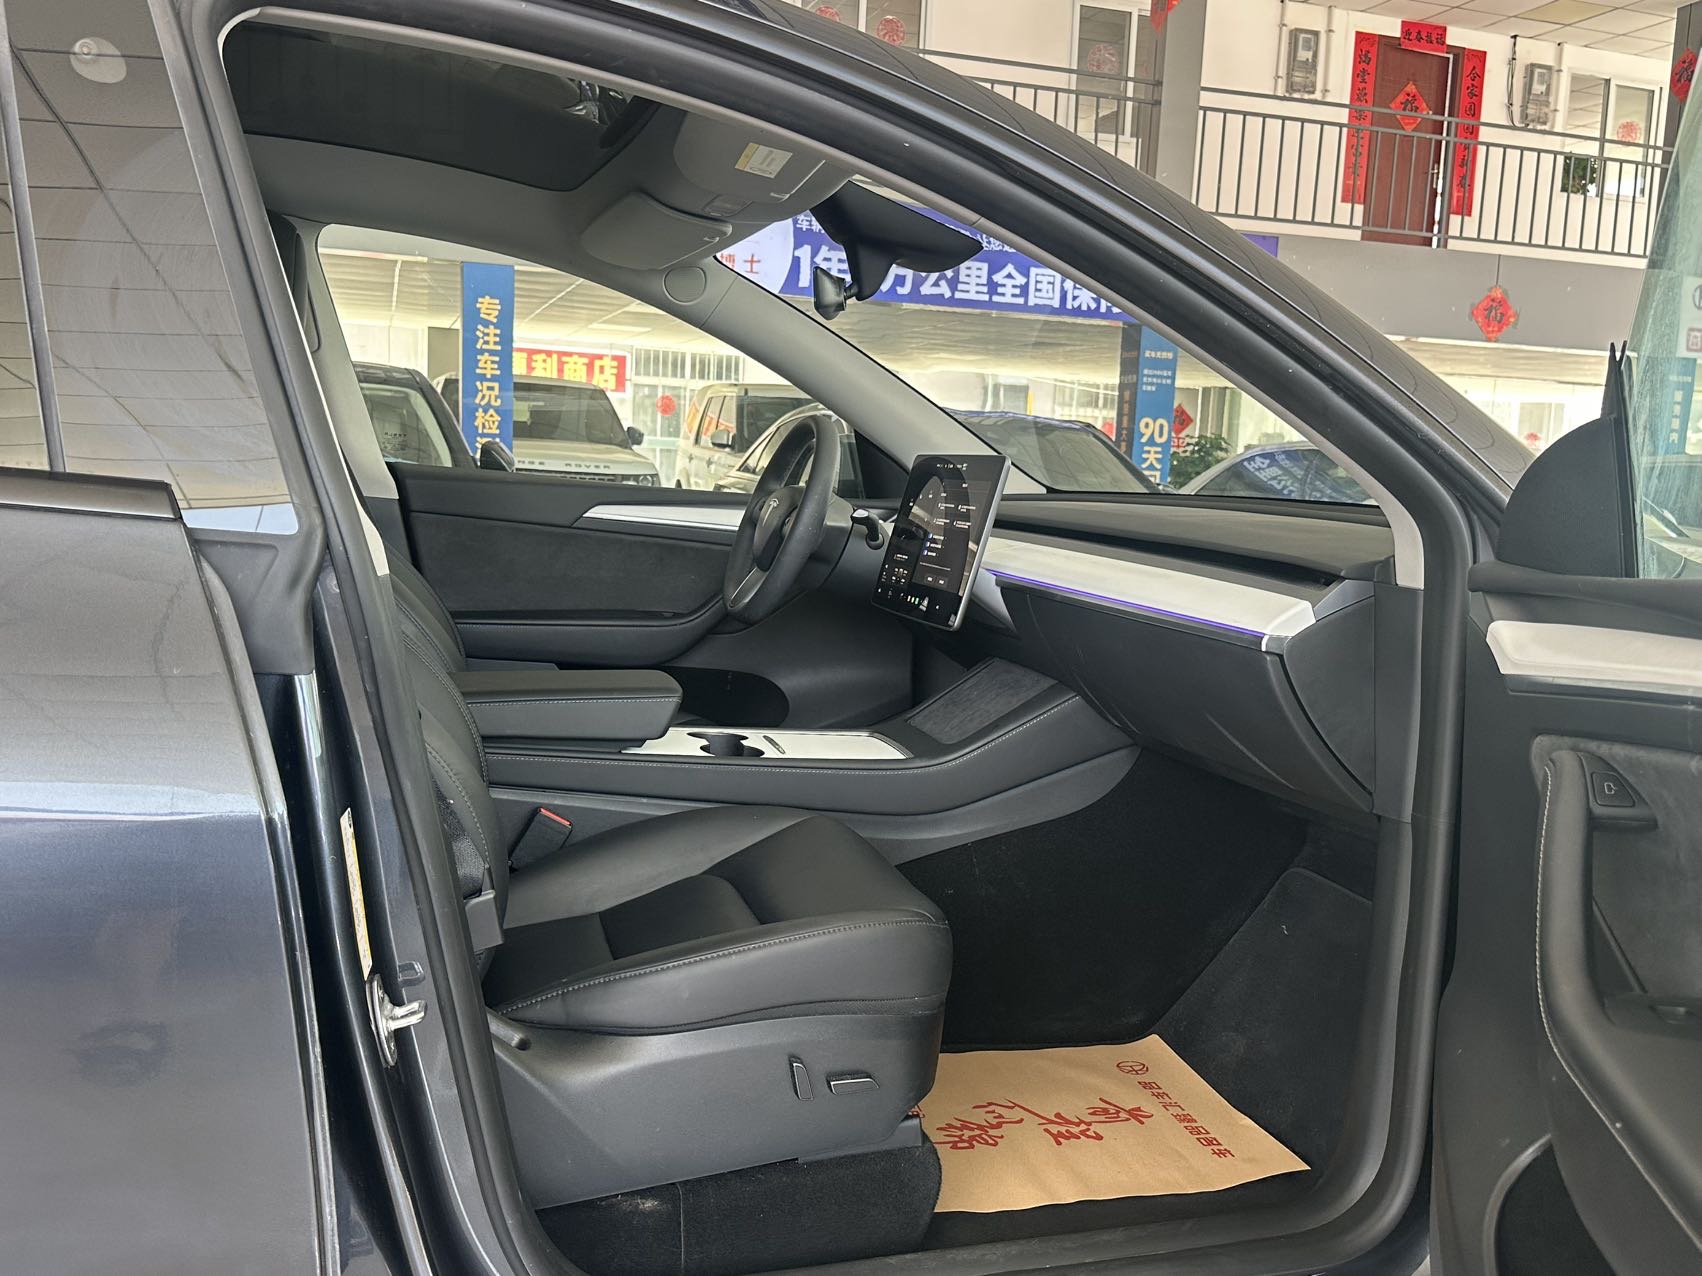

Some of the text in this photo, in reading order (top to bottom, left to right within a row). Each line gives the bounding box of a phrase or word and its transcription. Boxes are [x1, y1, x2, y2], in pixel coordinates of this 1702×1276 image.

[474, 295, 501, 463] 专注车况检
[564, 462, 611, 470] ROVER
[1137, 1081, 1235, 1158] 品车汇臻品名车
